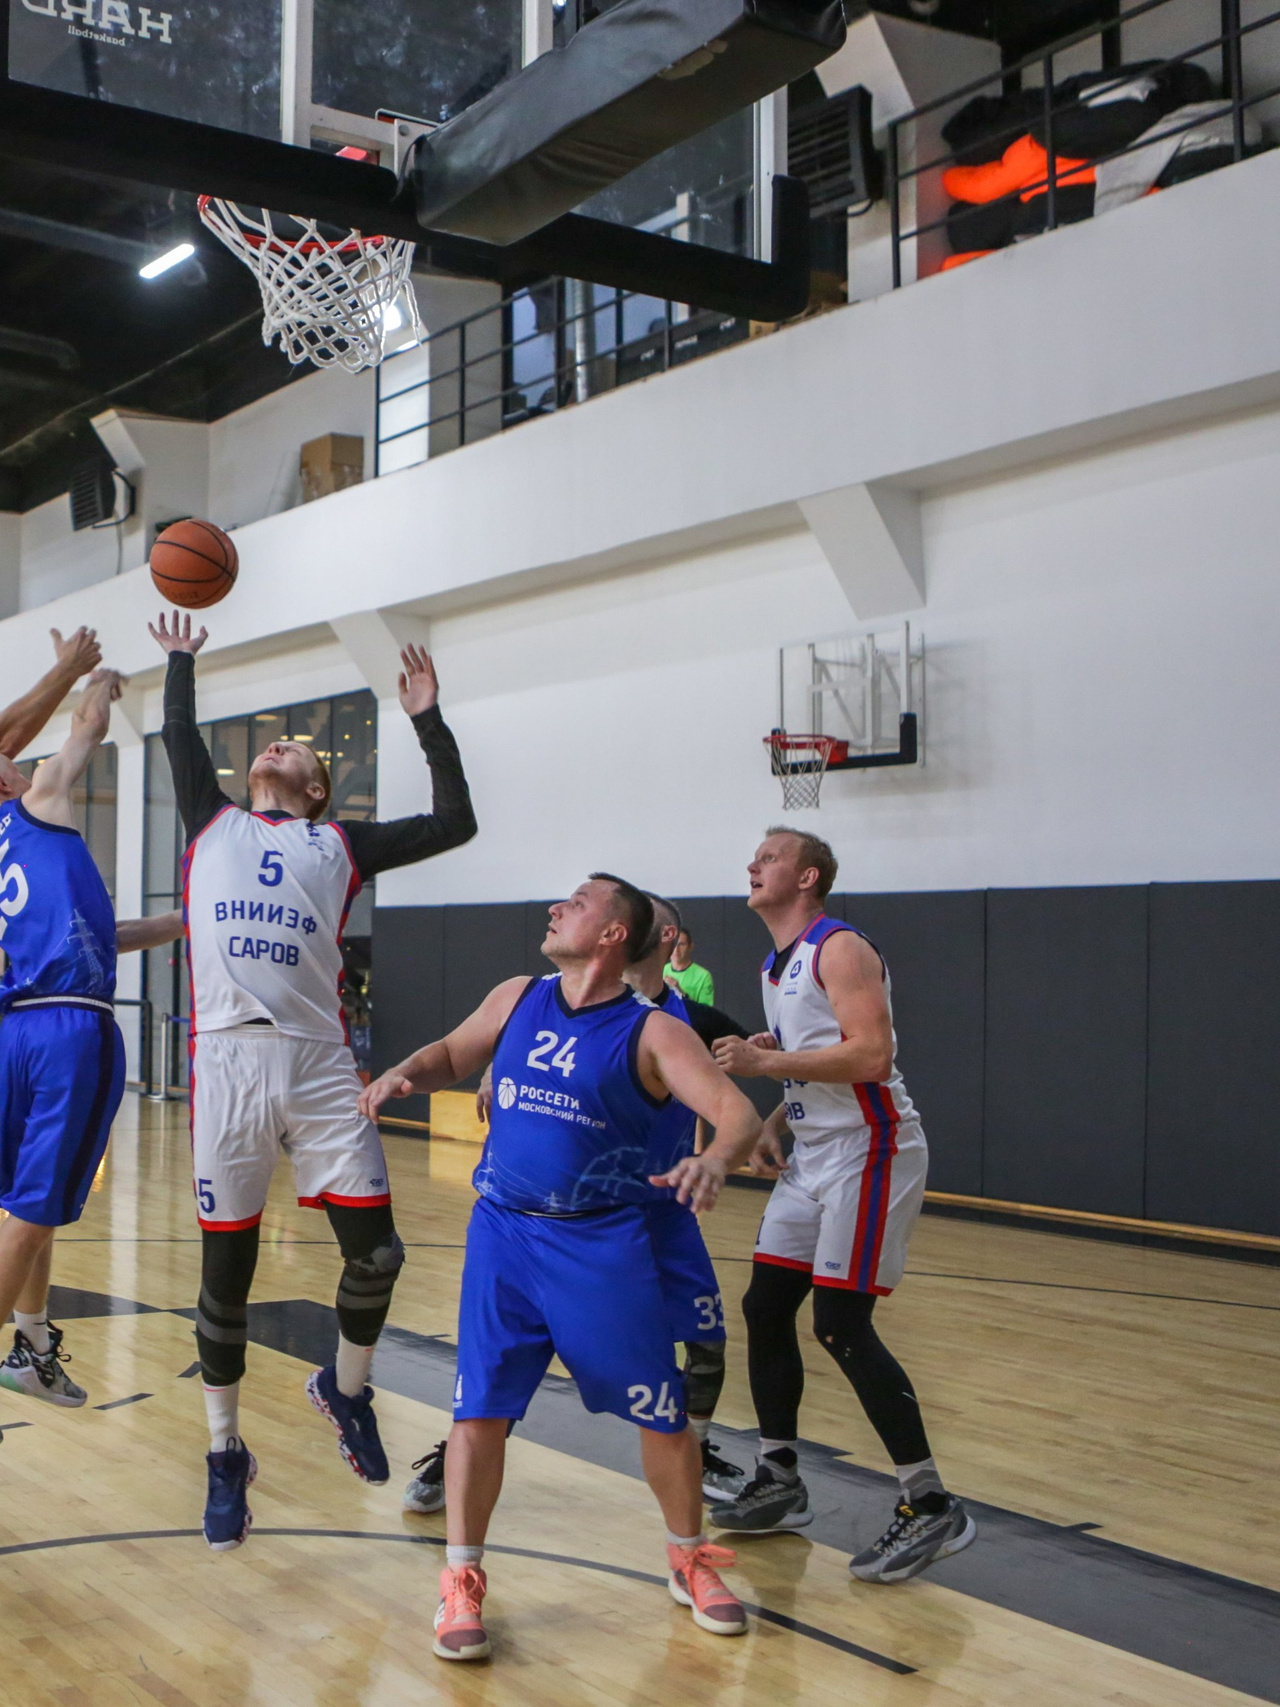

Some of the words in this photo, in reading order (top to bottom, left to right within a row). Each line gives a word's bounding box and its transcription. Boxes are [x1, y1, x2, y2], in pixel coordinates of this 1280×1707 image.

[258, 850, 283, 887] 5
[215, 900, 318, 935] ВНИИЭФ
[228, 936, 300, 967] САРОВ
[526, 1030, 578, 1078] 24
[518, 1101, 574, 1122] МОСКОВСКИЙ
[520, 1084, 580, 1110] РОССЕТИ
[198, 1178, 216, 1214] 5
[627, 1382, 678, 1424] 24
